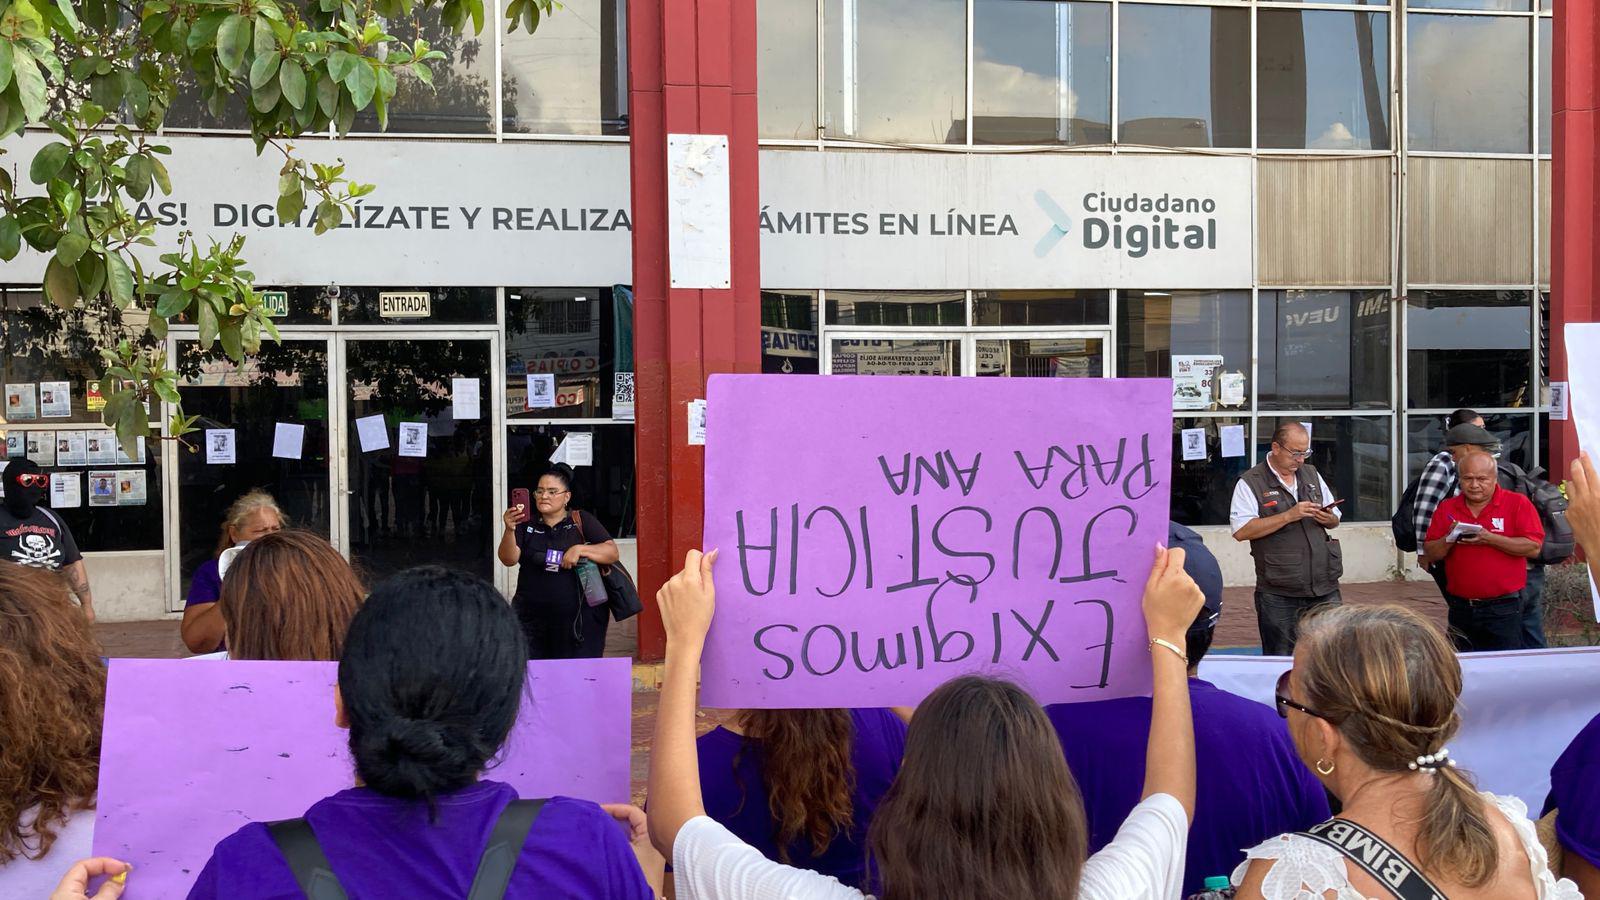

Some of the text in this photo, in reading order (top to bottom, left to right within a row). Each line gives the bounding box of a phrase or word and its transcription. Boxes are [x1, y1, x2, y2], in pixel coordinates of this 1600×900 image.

[213, 199, 450, 229] DIGÍZATE
[459, 206, 482, 230] Y
[492, 207, 633, 231] REALIZA
[879, 213, 918, 235] EN
[930, 208, 1019, 236] LÍNEA
[1083, 191, 1216, 213] Ciudadano
[1083, 215, 1216, 258] Digital
[383, 296, 428, 312] ENTRADA
[877, 449, 982, 497] ANA
[1014, 433, 1160, 500] PARA
